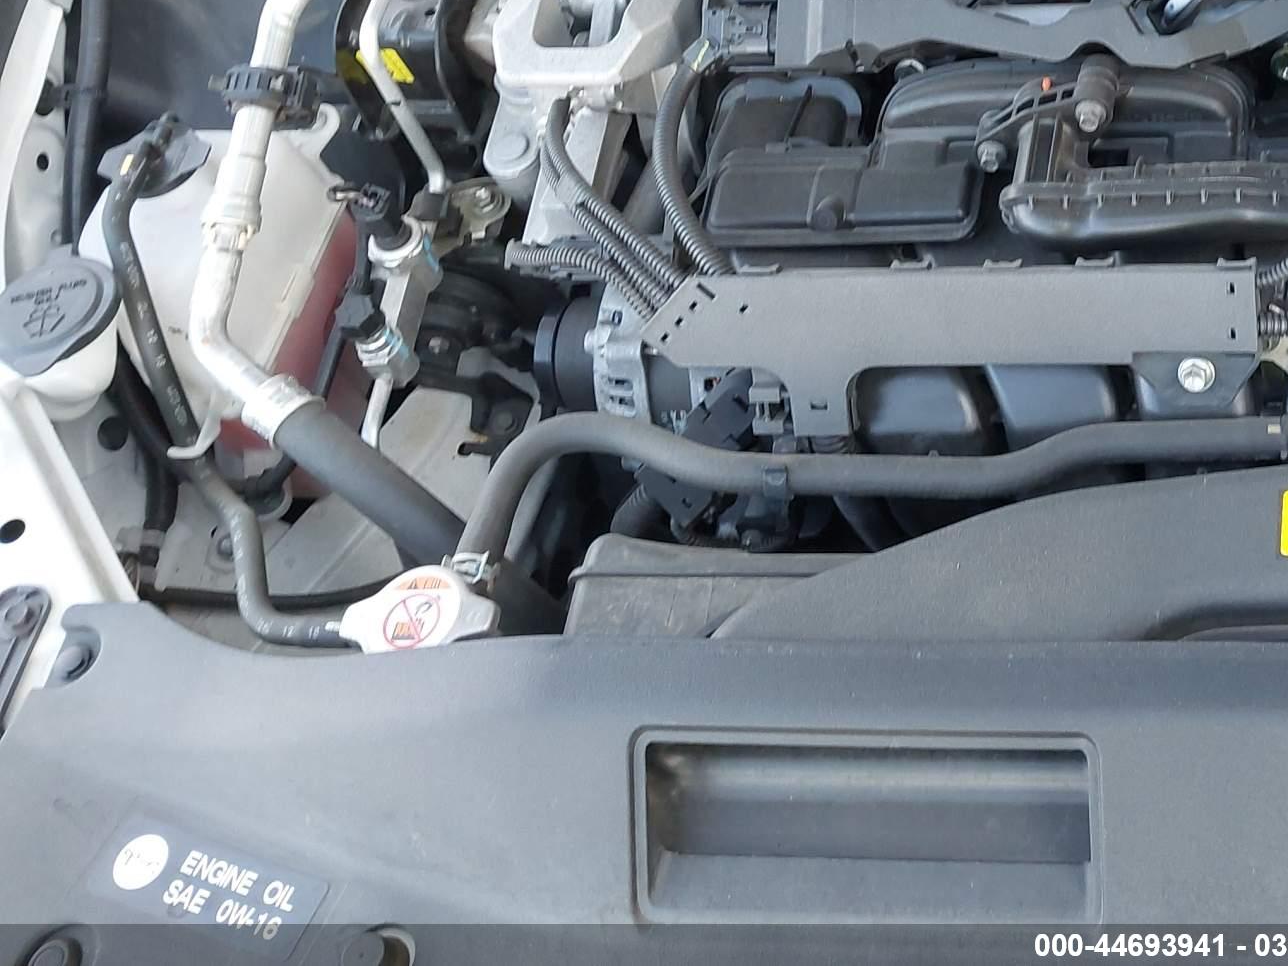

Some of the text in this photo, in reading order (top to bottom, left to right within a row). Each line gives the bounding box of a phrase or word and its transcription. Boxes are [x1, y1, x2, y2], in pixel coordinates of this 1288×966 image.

[162, 879, 283, 941] SAE 0W-16
[180, 850, 259, 896] ENGINE
[262, 880, 296, 912] OIL
